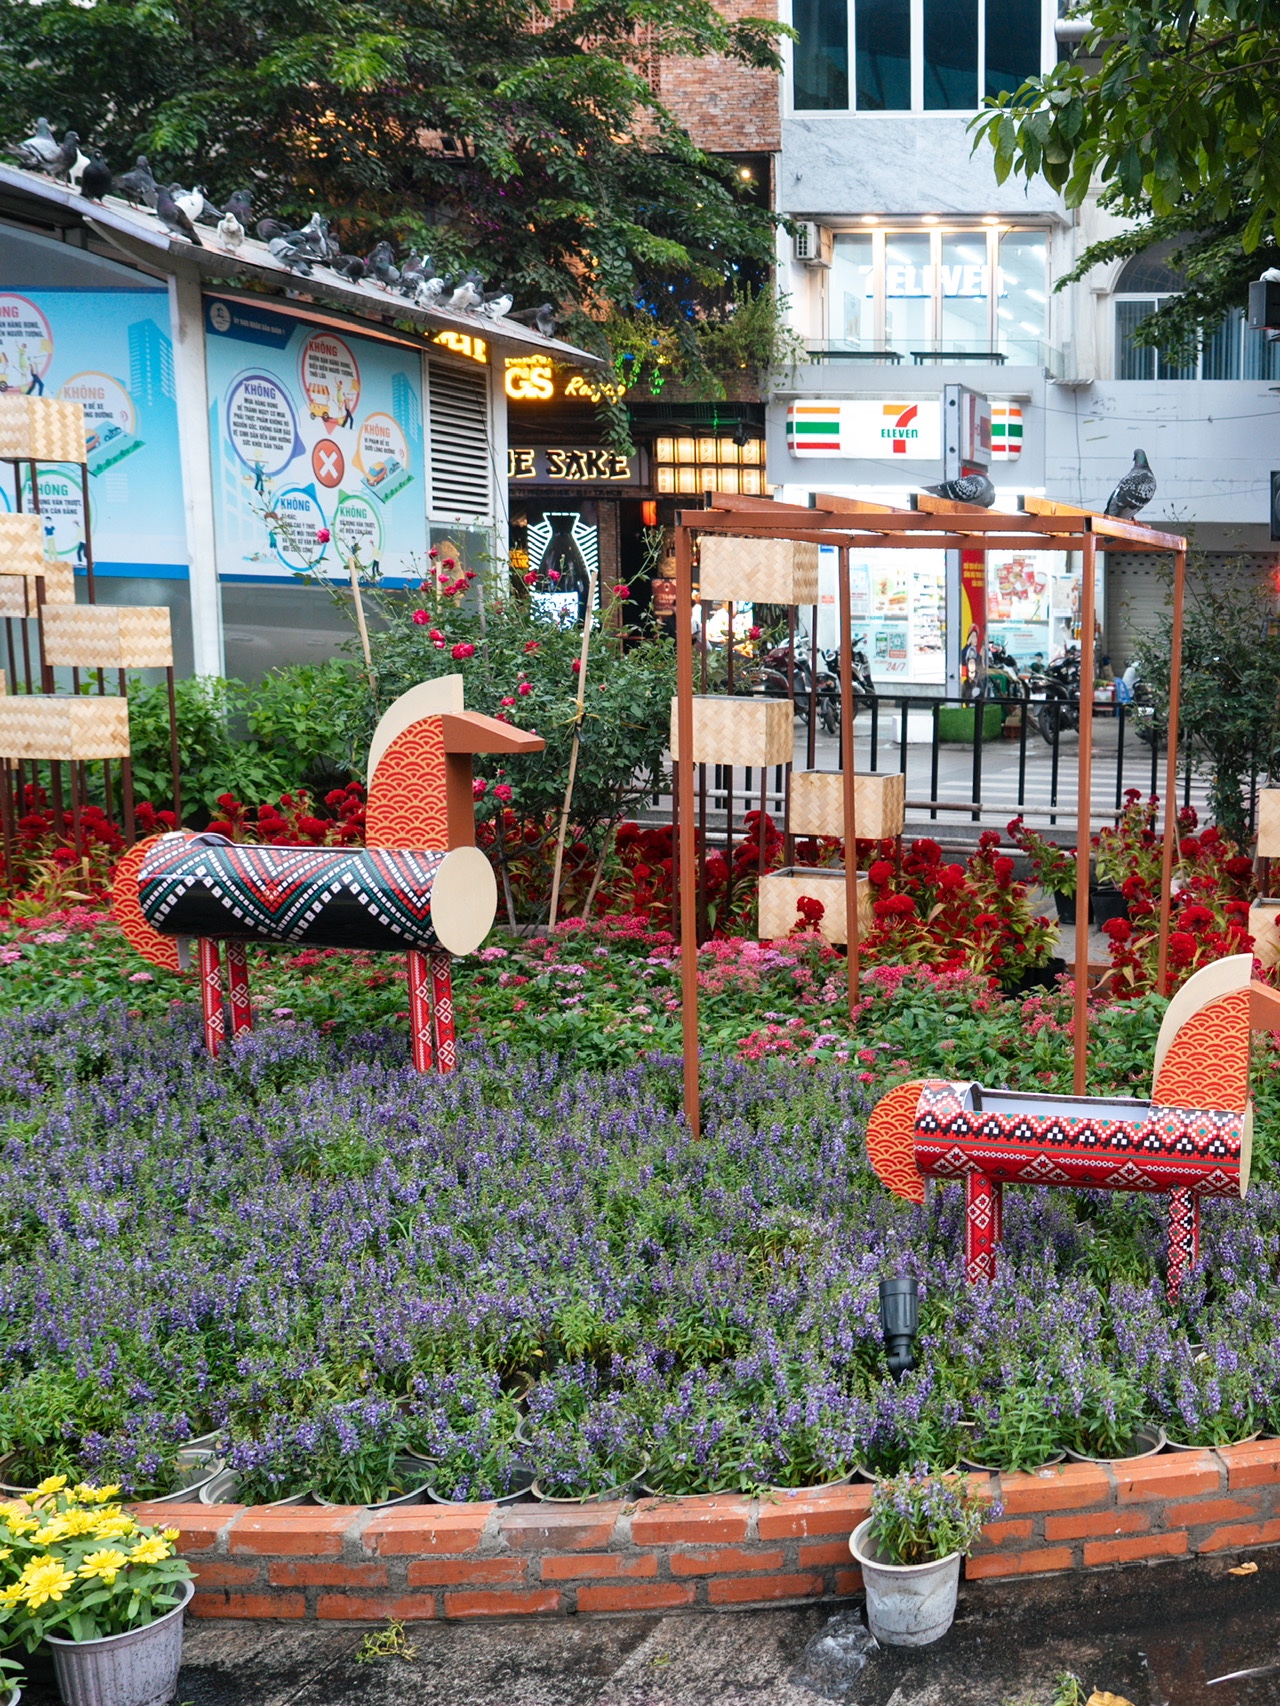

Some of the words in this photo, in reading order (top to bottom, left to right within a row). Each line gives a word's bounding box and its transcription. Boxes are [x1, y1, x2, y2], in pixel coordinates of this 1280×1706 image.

[308, 340, 338, 356] KHÔNG
[64, 385, 105, 400] KHÔNG
[244, 383, 276, 400] KHÔNG
[364, 423, 391, 438] KHÔNG
[280, 497, 310, 512] KHÔNG
[340, 505, 367, 519] KHÔNG
[886, 662, 906, 671] 24/7
